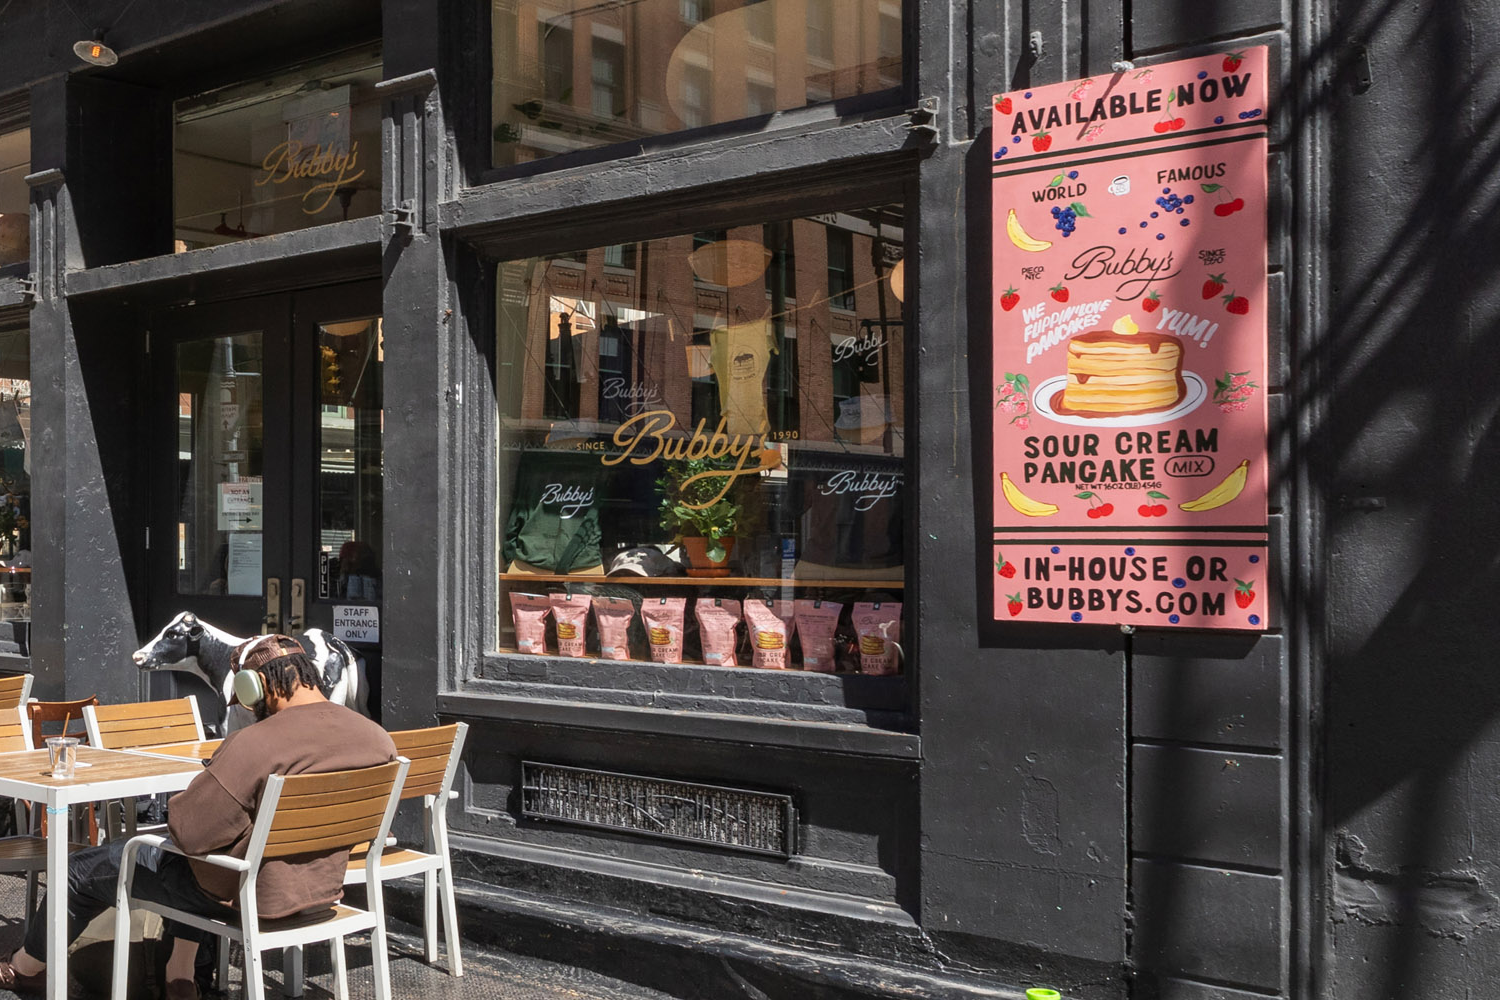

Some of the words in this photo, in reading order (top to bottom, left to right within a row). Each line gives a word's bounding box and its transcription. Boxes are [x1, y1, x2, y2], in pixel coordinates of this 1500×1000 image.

[1011, 89, 1162, 135] AVAILABLE
[1177, 73, 1251, 107] NOW
[254, 141, 365, 216] Bubby's
[1032, 183, 1087, 203] WORLD
[1157, 163, 1226, 184] FAMOUS
[1064, 245, 1181, 301] Bubby's
[1022, 302, 1046, 324] WE
[1078, 299, 1112, 315] LOVE
[1026, 313, 1102, 364] PANCAKES
[1156, 307, 1219, 348] YUM!
[576, 441, 605, 451] SINCE
[601, 410, 783, 510] Bubby's
[772, 431, 799, 440] 1990
[1024, 433, 1100, 459] SOUR
[1115, 428, 1219, 455] CREAM
[1024, 458, 1155, 484] PANCAKE
[1173, 460, 1204, 474] MIX
[540, 483, 594, 519] Bubby's
[821, 470, 896, 511] Bubby's
[1024, 556, 1169, 582] IN-HOUSE
[1186, 556, 1228, 582] OR
[343, 608, 369, 617] STAFF
[1026, 587, 1227, 616] BUBBYS.COM
[334, 619, 378, 628] ENTRANCE
[345, 630, 368, 639] ONLY
